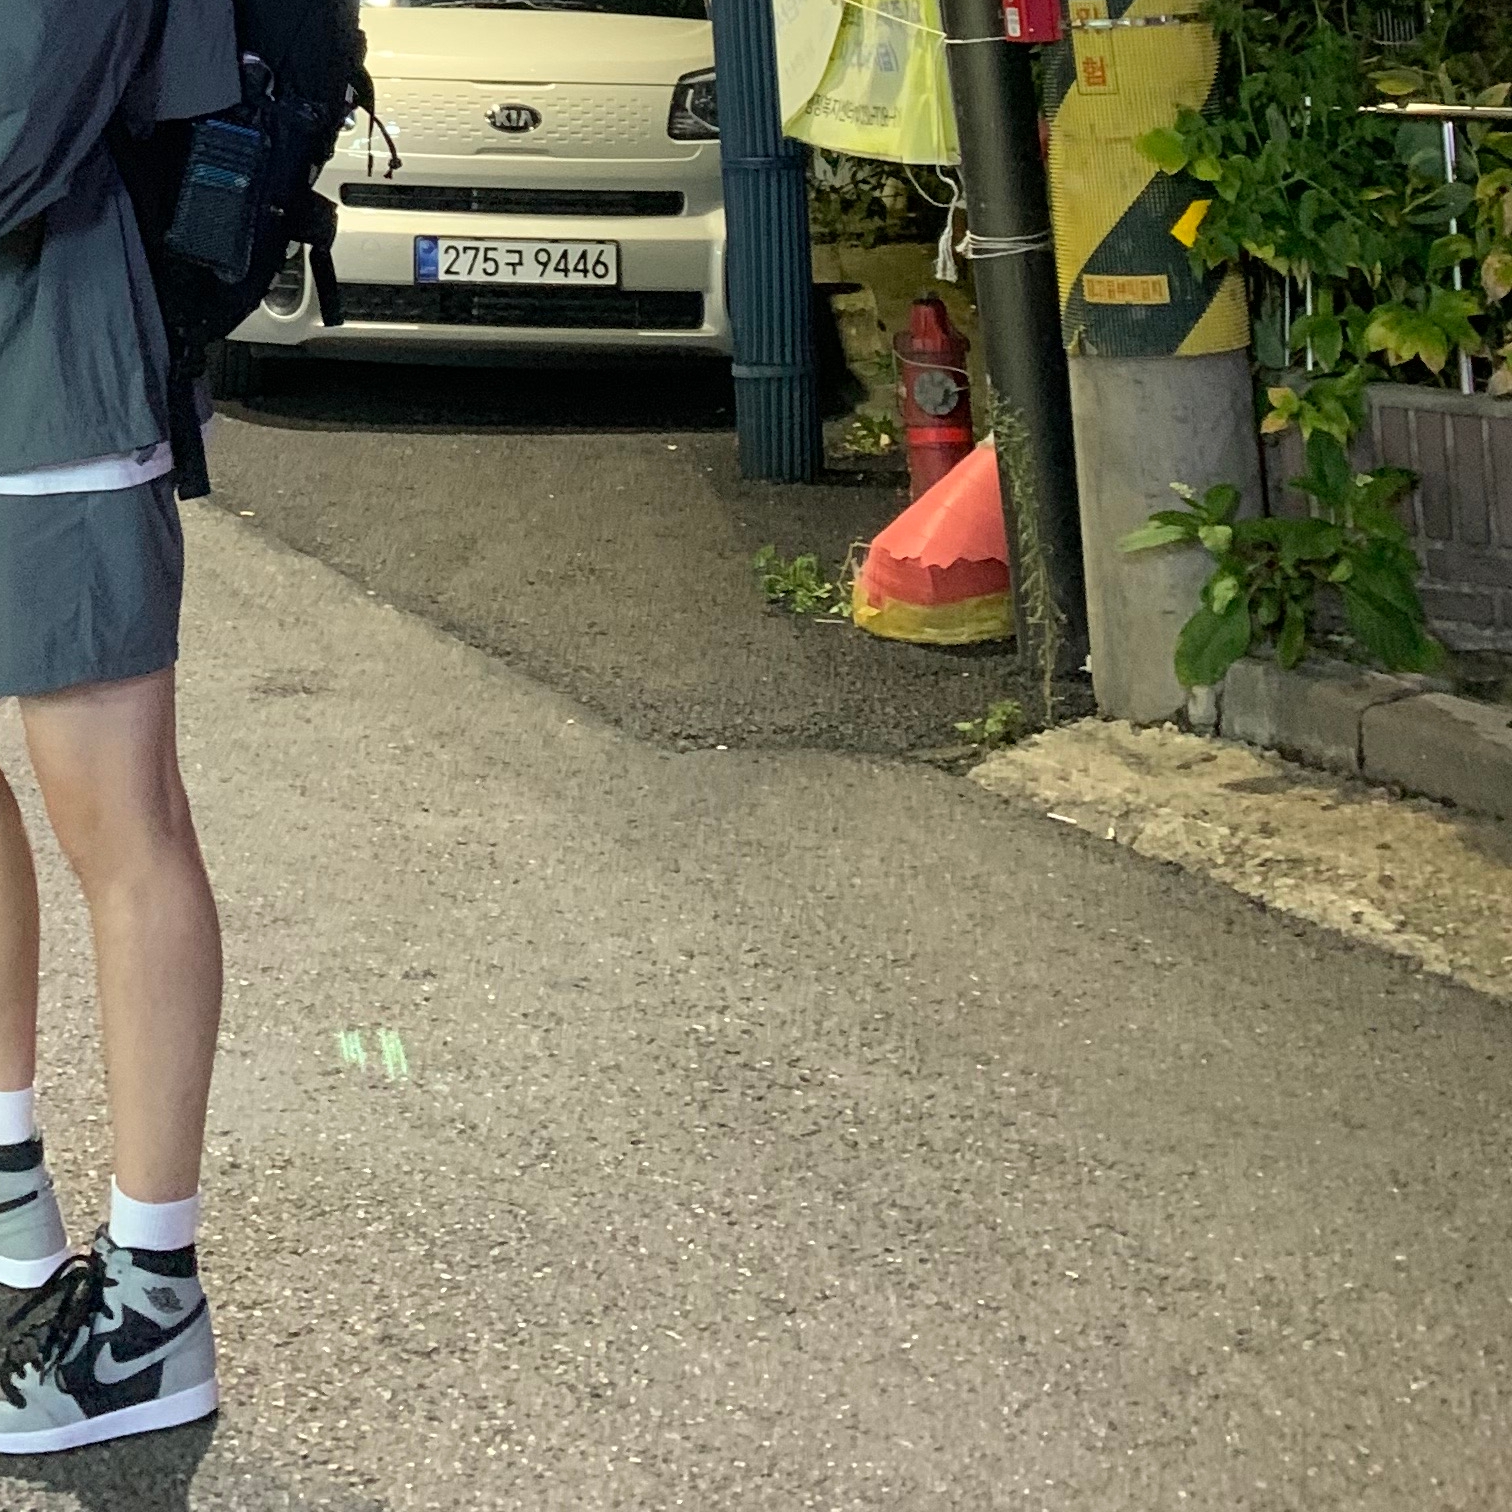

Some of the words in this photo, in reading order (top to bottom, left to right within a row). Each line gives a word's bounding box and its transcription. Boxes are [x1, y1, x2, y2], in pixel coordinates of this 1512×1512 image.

[494, 109, 535, 127] KIA
[443, 244, 524, 277] 275구
[533, 247, 610, 279] 9446
